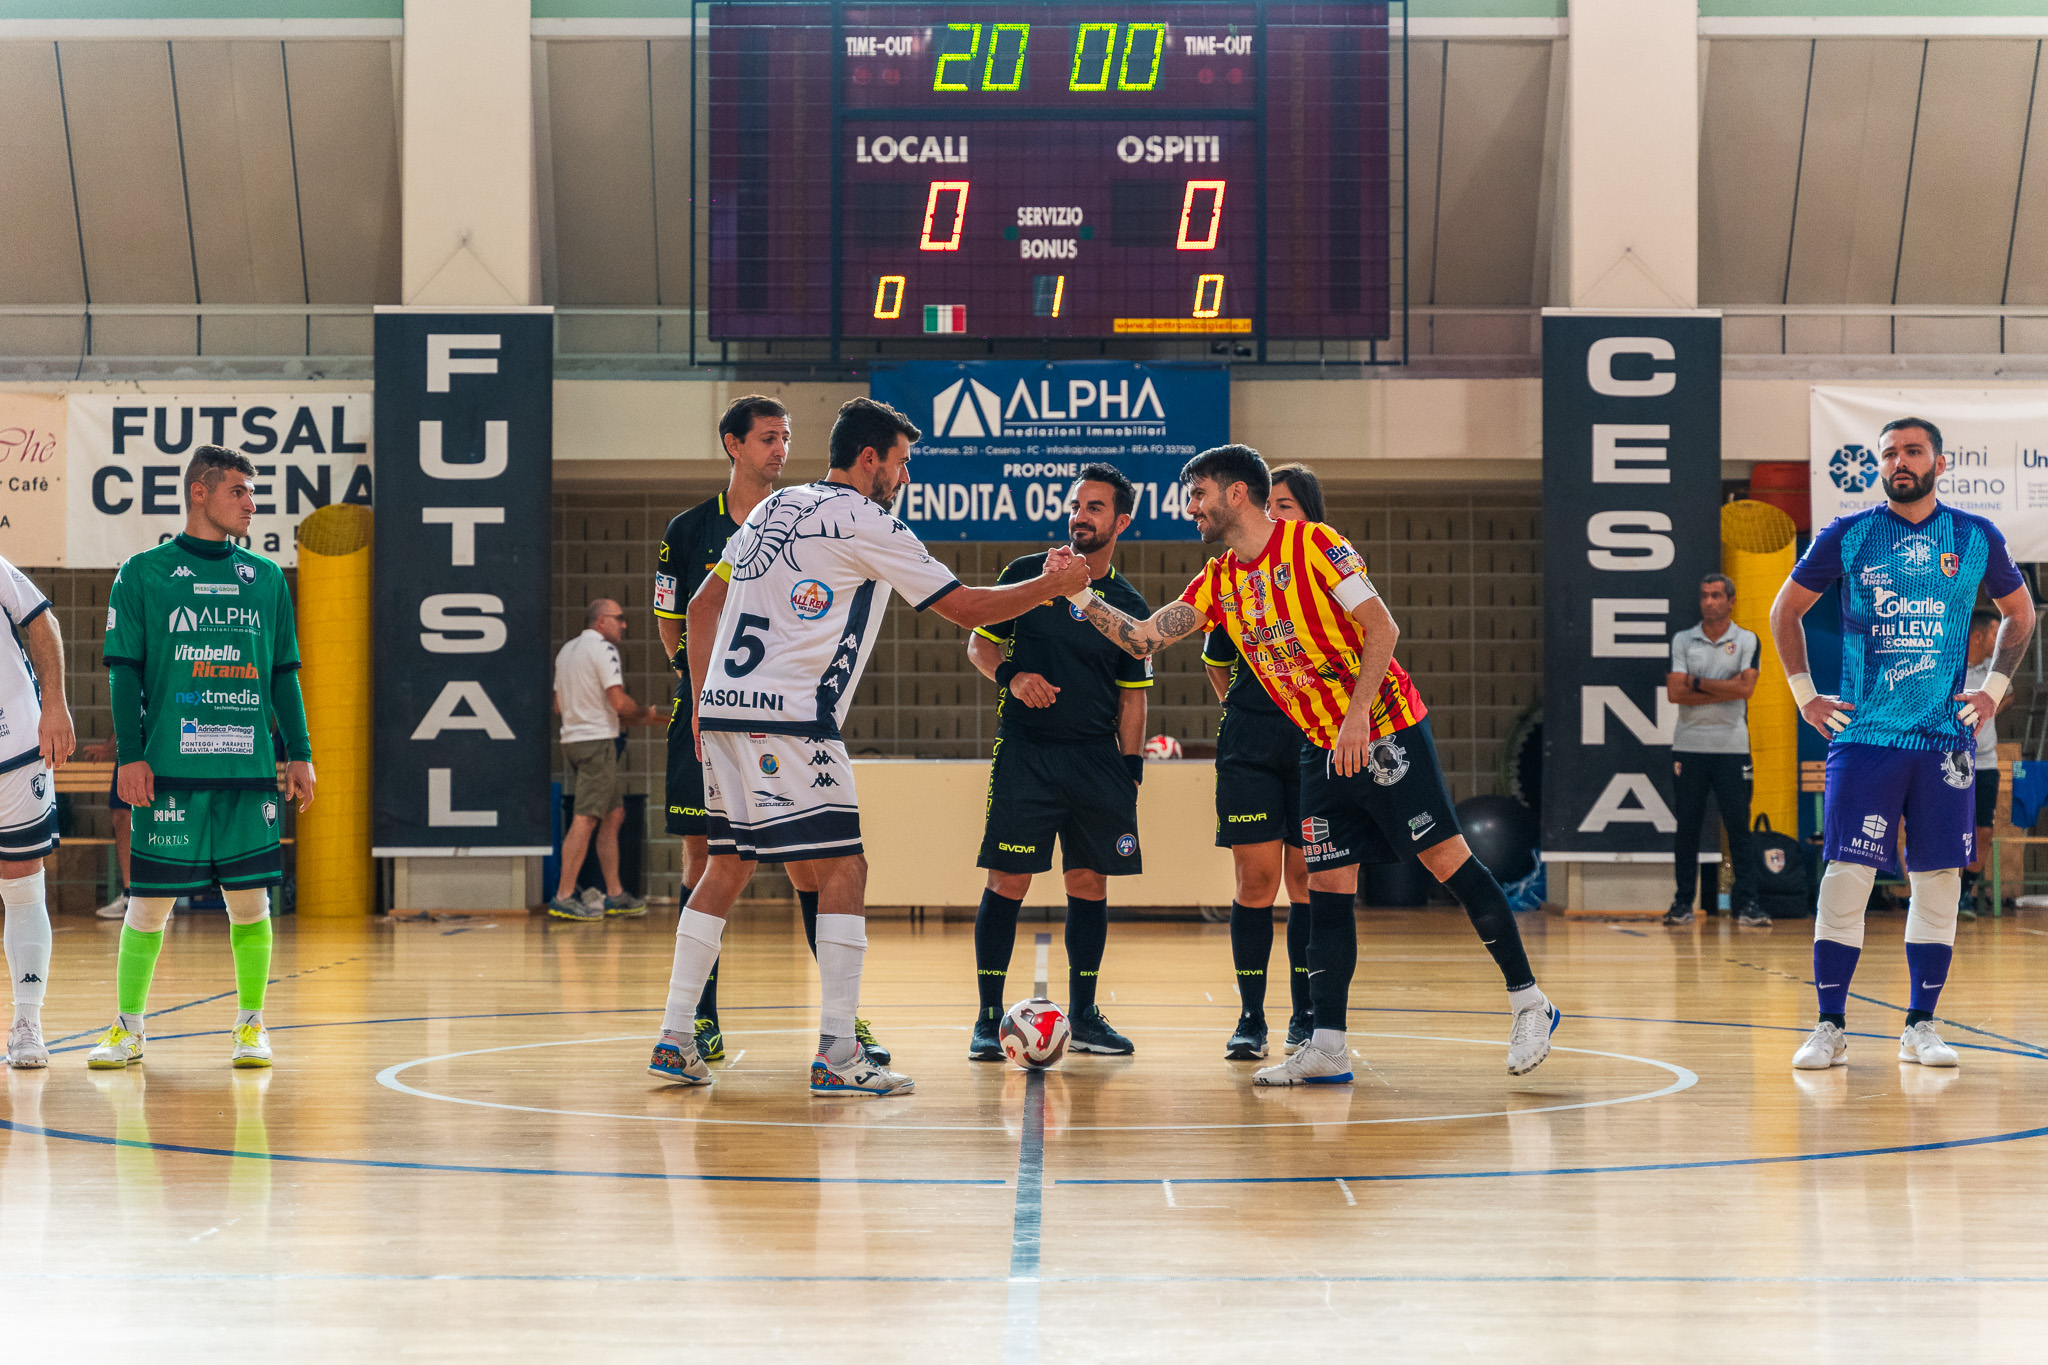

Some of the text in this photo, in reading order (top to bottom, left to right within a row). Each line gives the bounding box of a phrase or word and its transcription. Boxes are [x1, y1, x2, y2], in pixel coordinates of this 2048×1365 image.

[846, 37, 913, 56] TIME-OUT
[1185, 36, 1252, 55] TIME-OUT
[933, 23, 1166, 91] 20 00
[857, 136, 968, 163] LOCALI
[1117, 136, 1220, 163] OSPITI
[920, 181, 970, 251] 0
[1017, 207, 1083, 227] SERVIZIO
[1176, 181, 1226, 250] 0
[1020, 240, 1078, 259] BONUS
[874, 276, 906, 319] 0
[1050, 276, 1065, 317] 1
[1192, 274, 1224, 318] 0
[1004, 377, 1165, 419] ALPHA
[112, 406, 366, 454] FUTSAL
[1004, 426, 1166, 437] mediazioni immobiliari
[1945, 446, 1987, 471] gini
[1003, 463, 1077, 478] PROPONE
[92, 464, 373, 515] CEENA
[1937, 474, 2005, 494] ciano
[410, 334, 516, 827] FUTSAL
[1577, 336, 1679, 833] CESENA
[199, 606, 261, 629] ALPHA
[1899, 621, 1943, 636] LEVA
[175, 645, 240, 661] Vitobello
[724, 613, 770, 678] 5
[1271, 641, 1306, 660] LEVA
[1893, 638, 1934, 647] CONAD
[175, 689, 260, 706] nextmedia
[154, 810, 185, 821] NMC
[1229, 813, 1267, 822] GIVOVA
[999, 842, 1035, 853] GIVOVA
[1851, 838, 1884, 855] MEDIL
